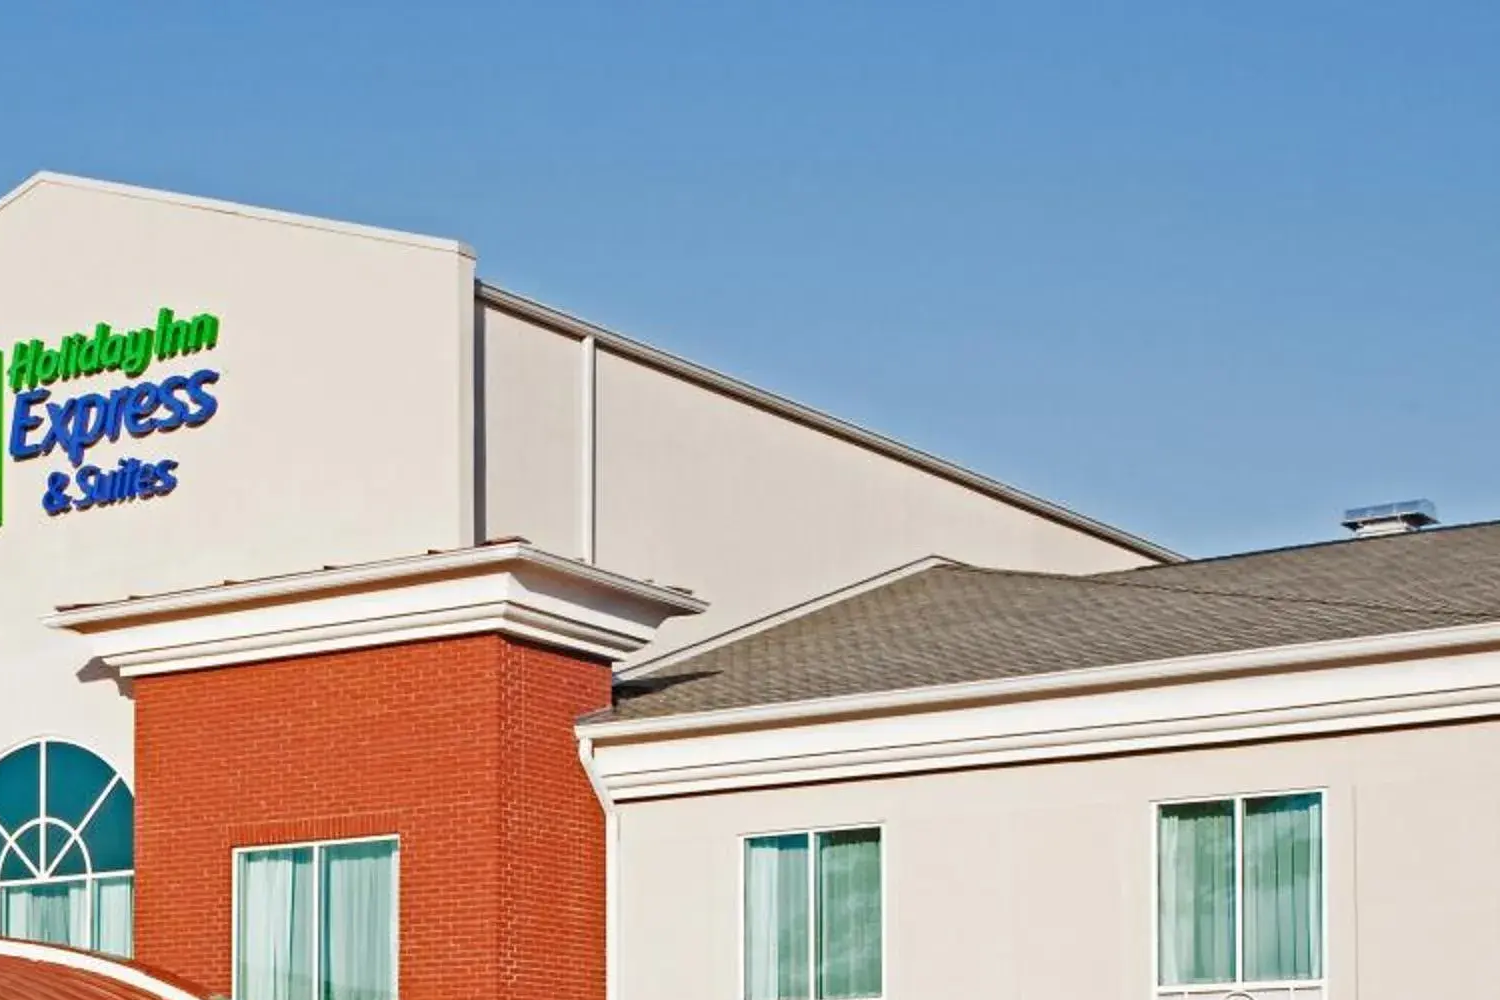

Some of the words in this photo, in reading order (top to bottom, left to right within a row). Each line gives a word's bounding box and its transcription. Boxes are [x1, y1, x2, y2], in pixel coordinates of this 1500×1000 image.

[7, 322, 154, 392] Holiday
[154, 307, 219, 360] Inn
[8, 368, 220, 467] Express
[42, 471, 72, 516] &
[74, 457, 179, 509] Suites
